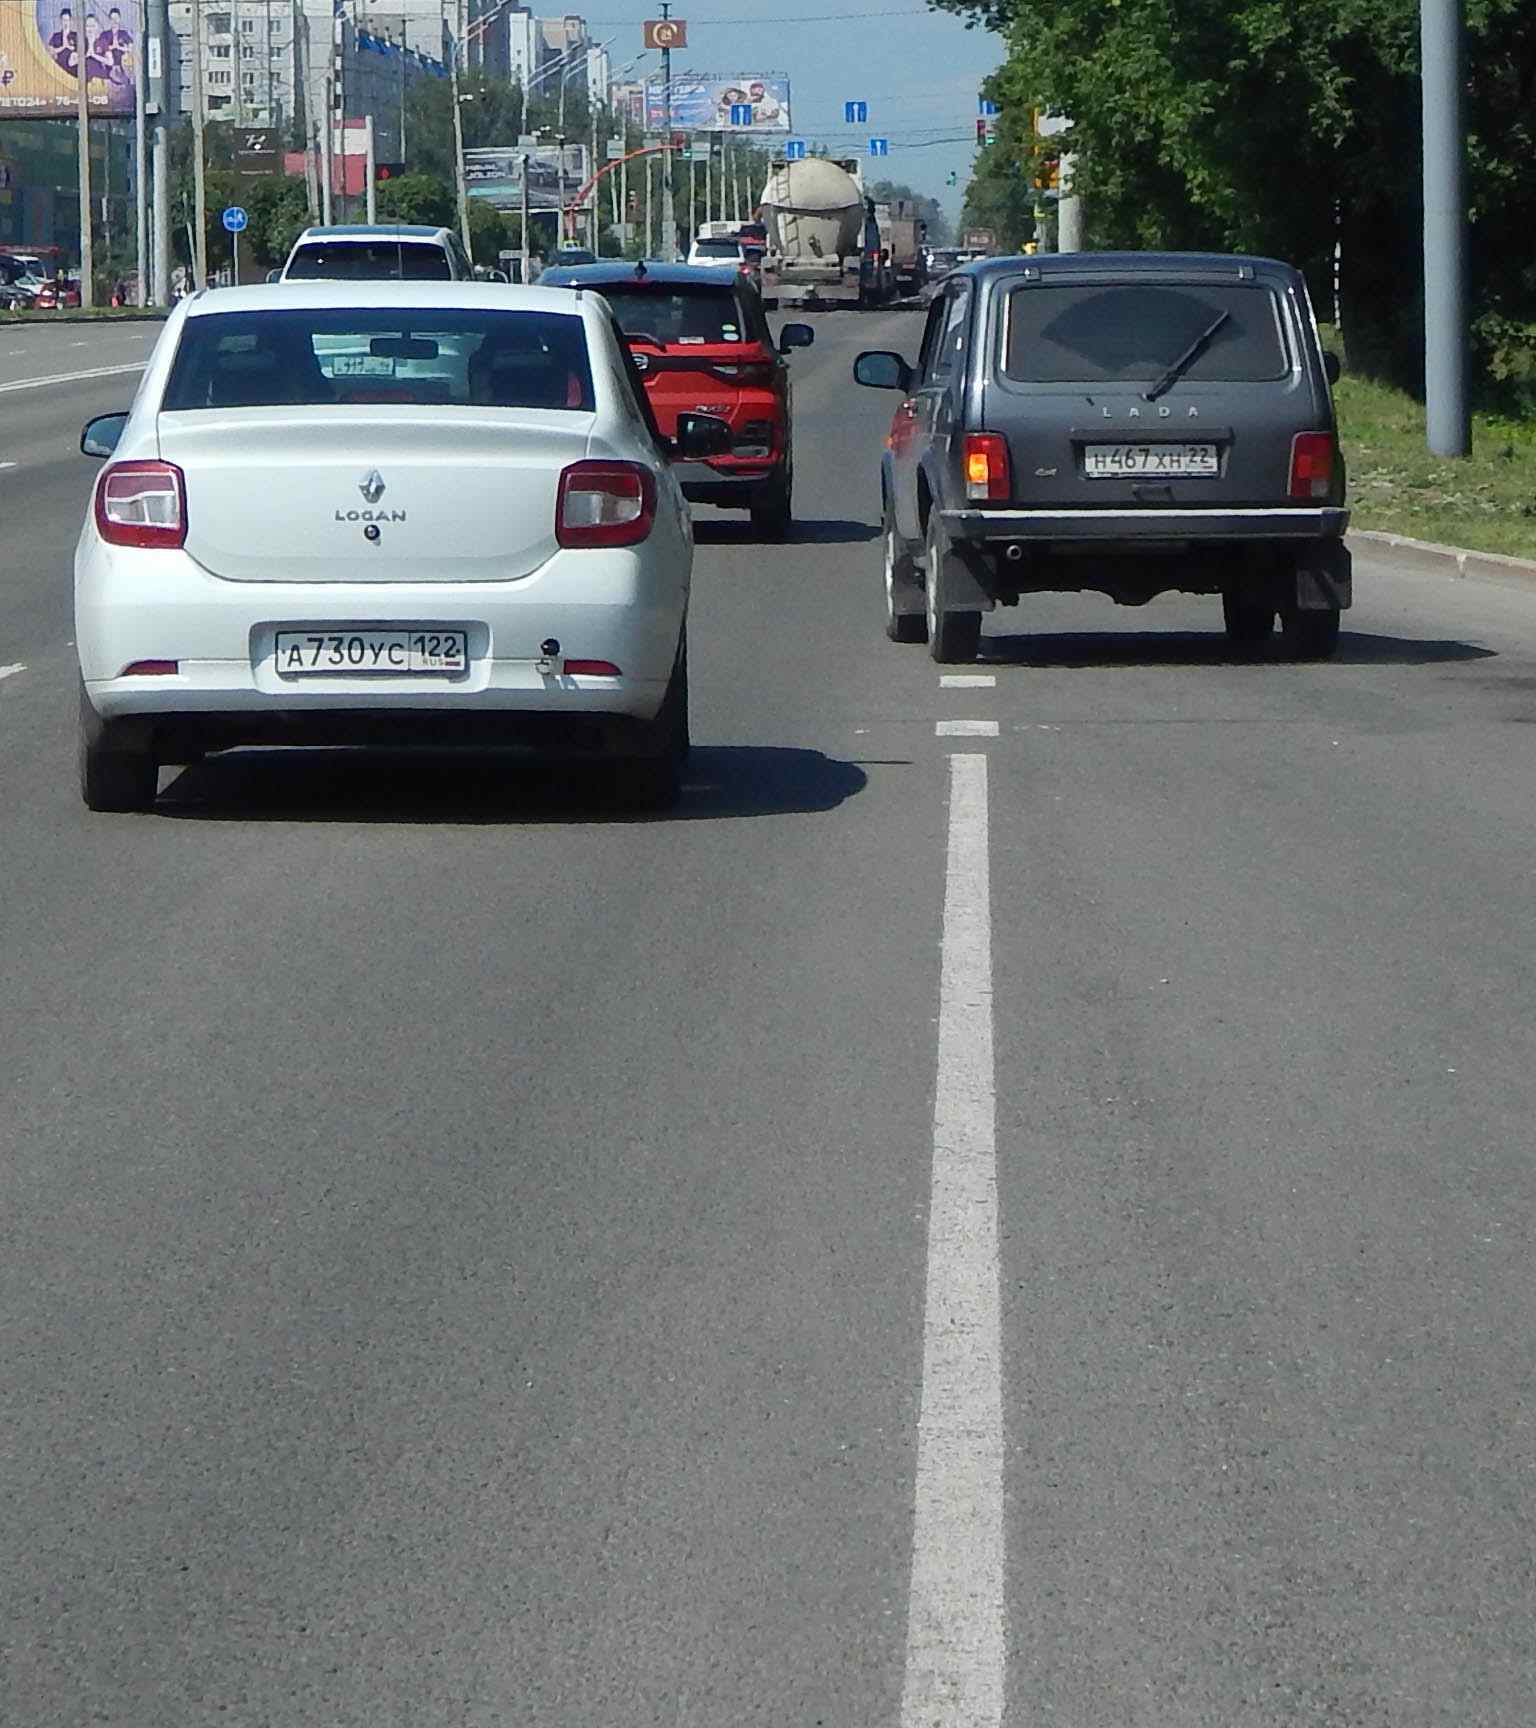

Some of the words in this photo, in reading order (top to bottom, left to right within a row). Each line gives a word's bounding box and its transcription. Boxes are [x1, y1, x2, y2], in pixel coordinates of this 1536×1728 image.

[1102, 406, 1200, 418] LADA
[1188, 447, 1209, 464] 22
[335, 510, 406, 522] LOGAN
[287, 636, 405, 667] А730УС
[413, 635, 457, 658] 122
